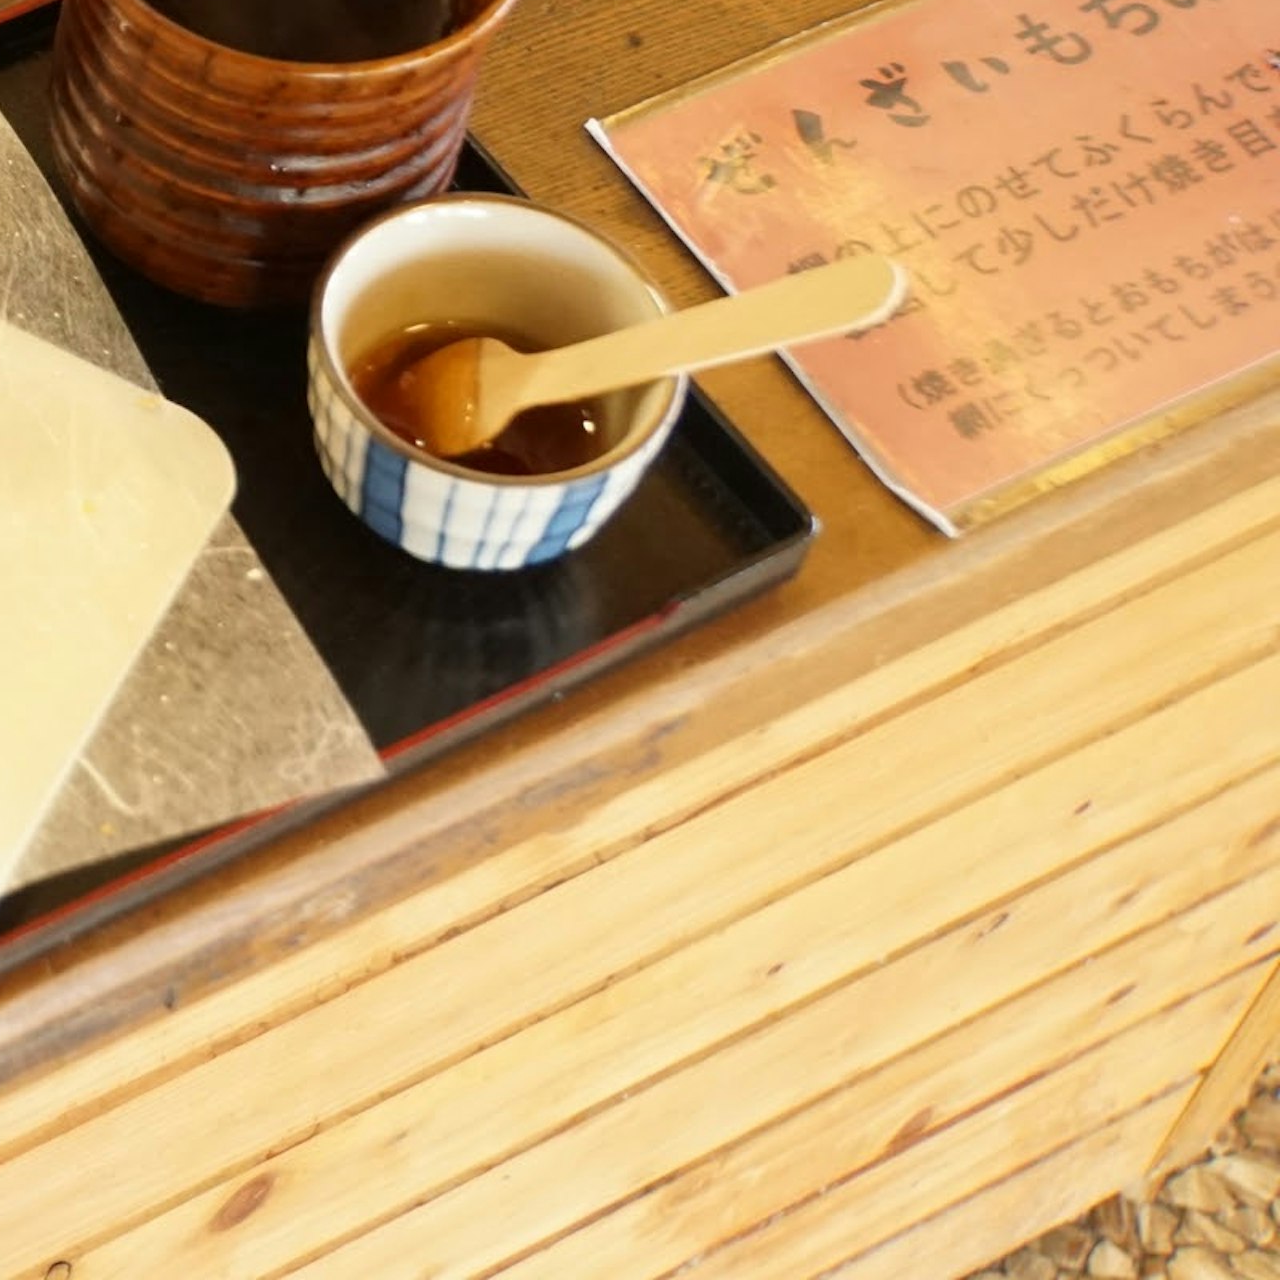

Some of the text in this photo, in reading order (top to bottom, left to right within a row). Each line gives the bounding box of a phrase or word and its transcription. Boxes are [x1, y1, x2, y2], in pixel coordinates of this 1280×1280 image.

[787, 48, 1280, 276] の上にのせてふくらんで
[946, 261, 1280, 441] 網にくっついてしまう
